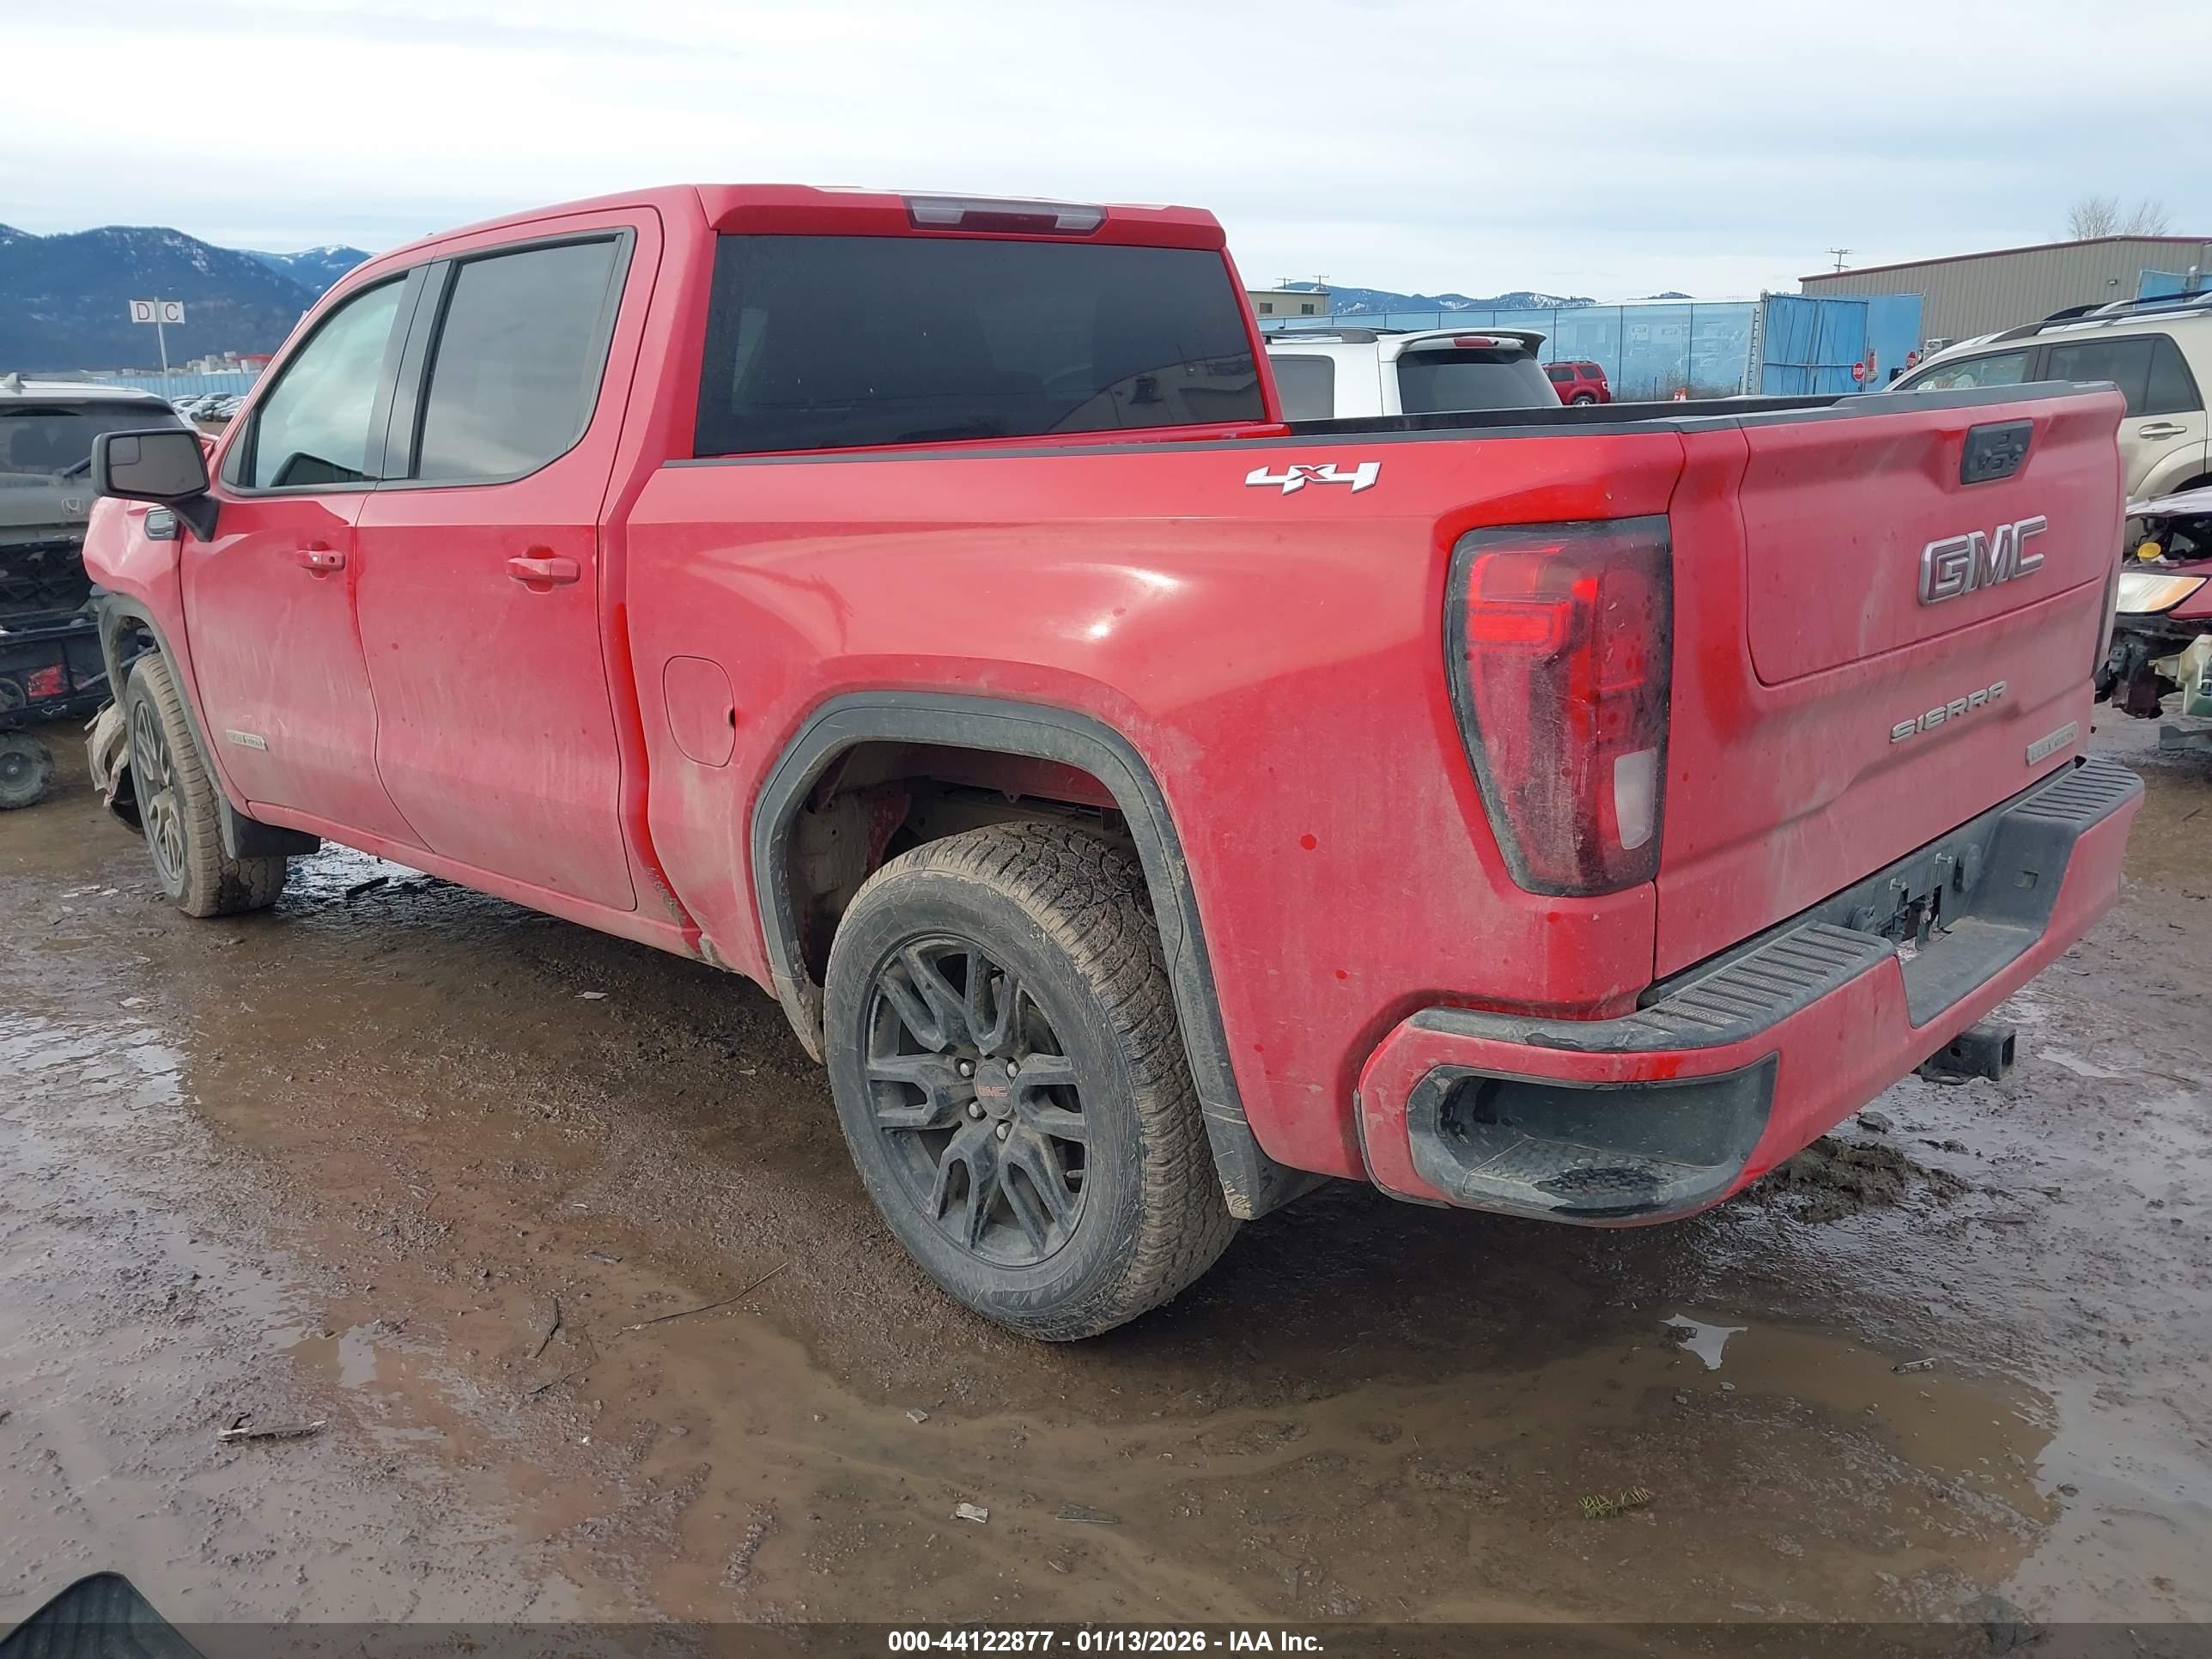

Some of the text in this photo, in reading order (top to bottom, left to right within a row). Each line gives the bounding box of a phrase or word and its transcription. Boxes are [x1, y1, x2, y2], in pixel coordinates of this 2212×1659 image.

[137, 302, 149, 320] D
[165, 303, 179, 321] C
[1918, 514, 2048, 606] GMC
[1889, 680, 2007, 744] SIERRA
[978, 1085, 1007, 1097] GMC
